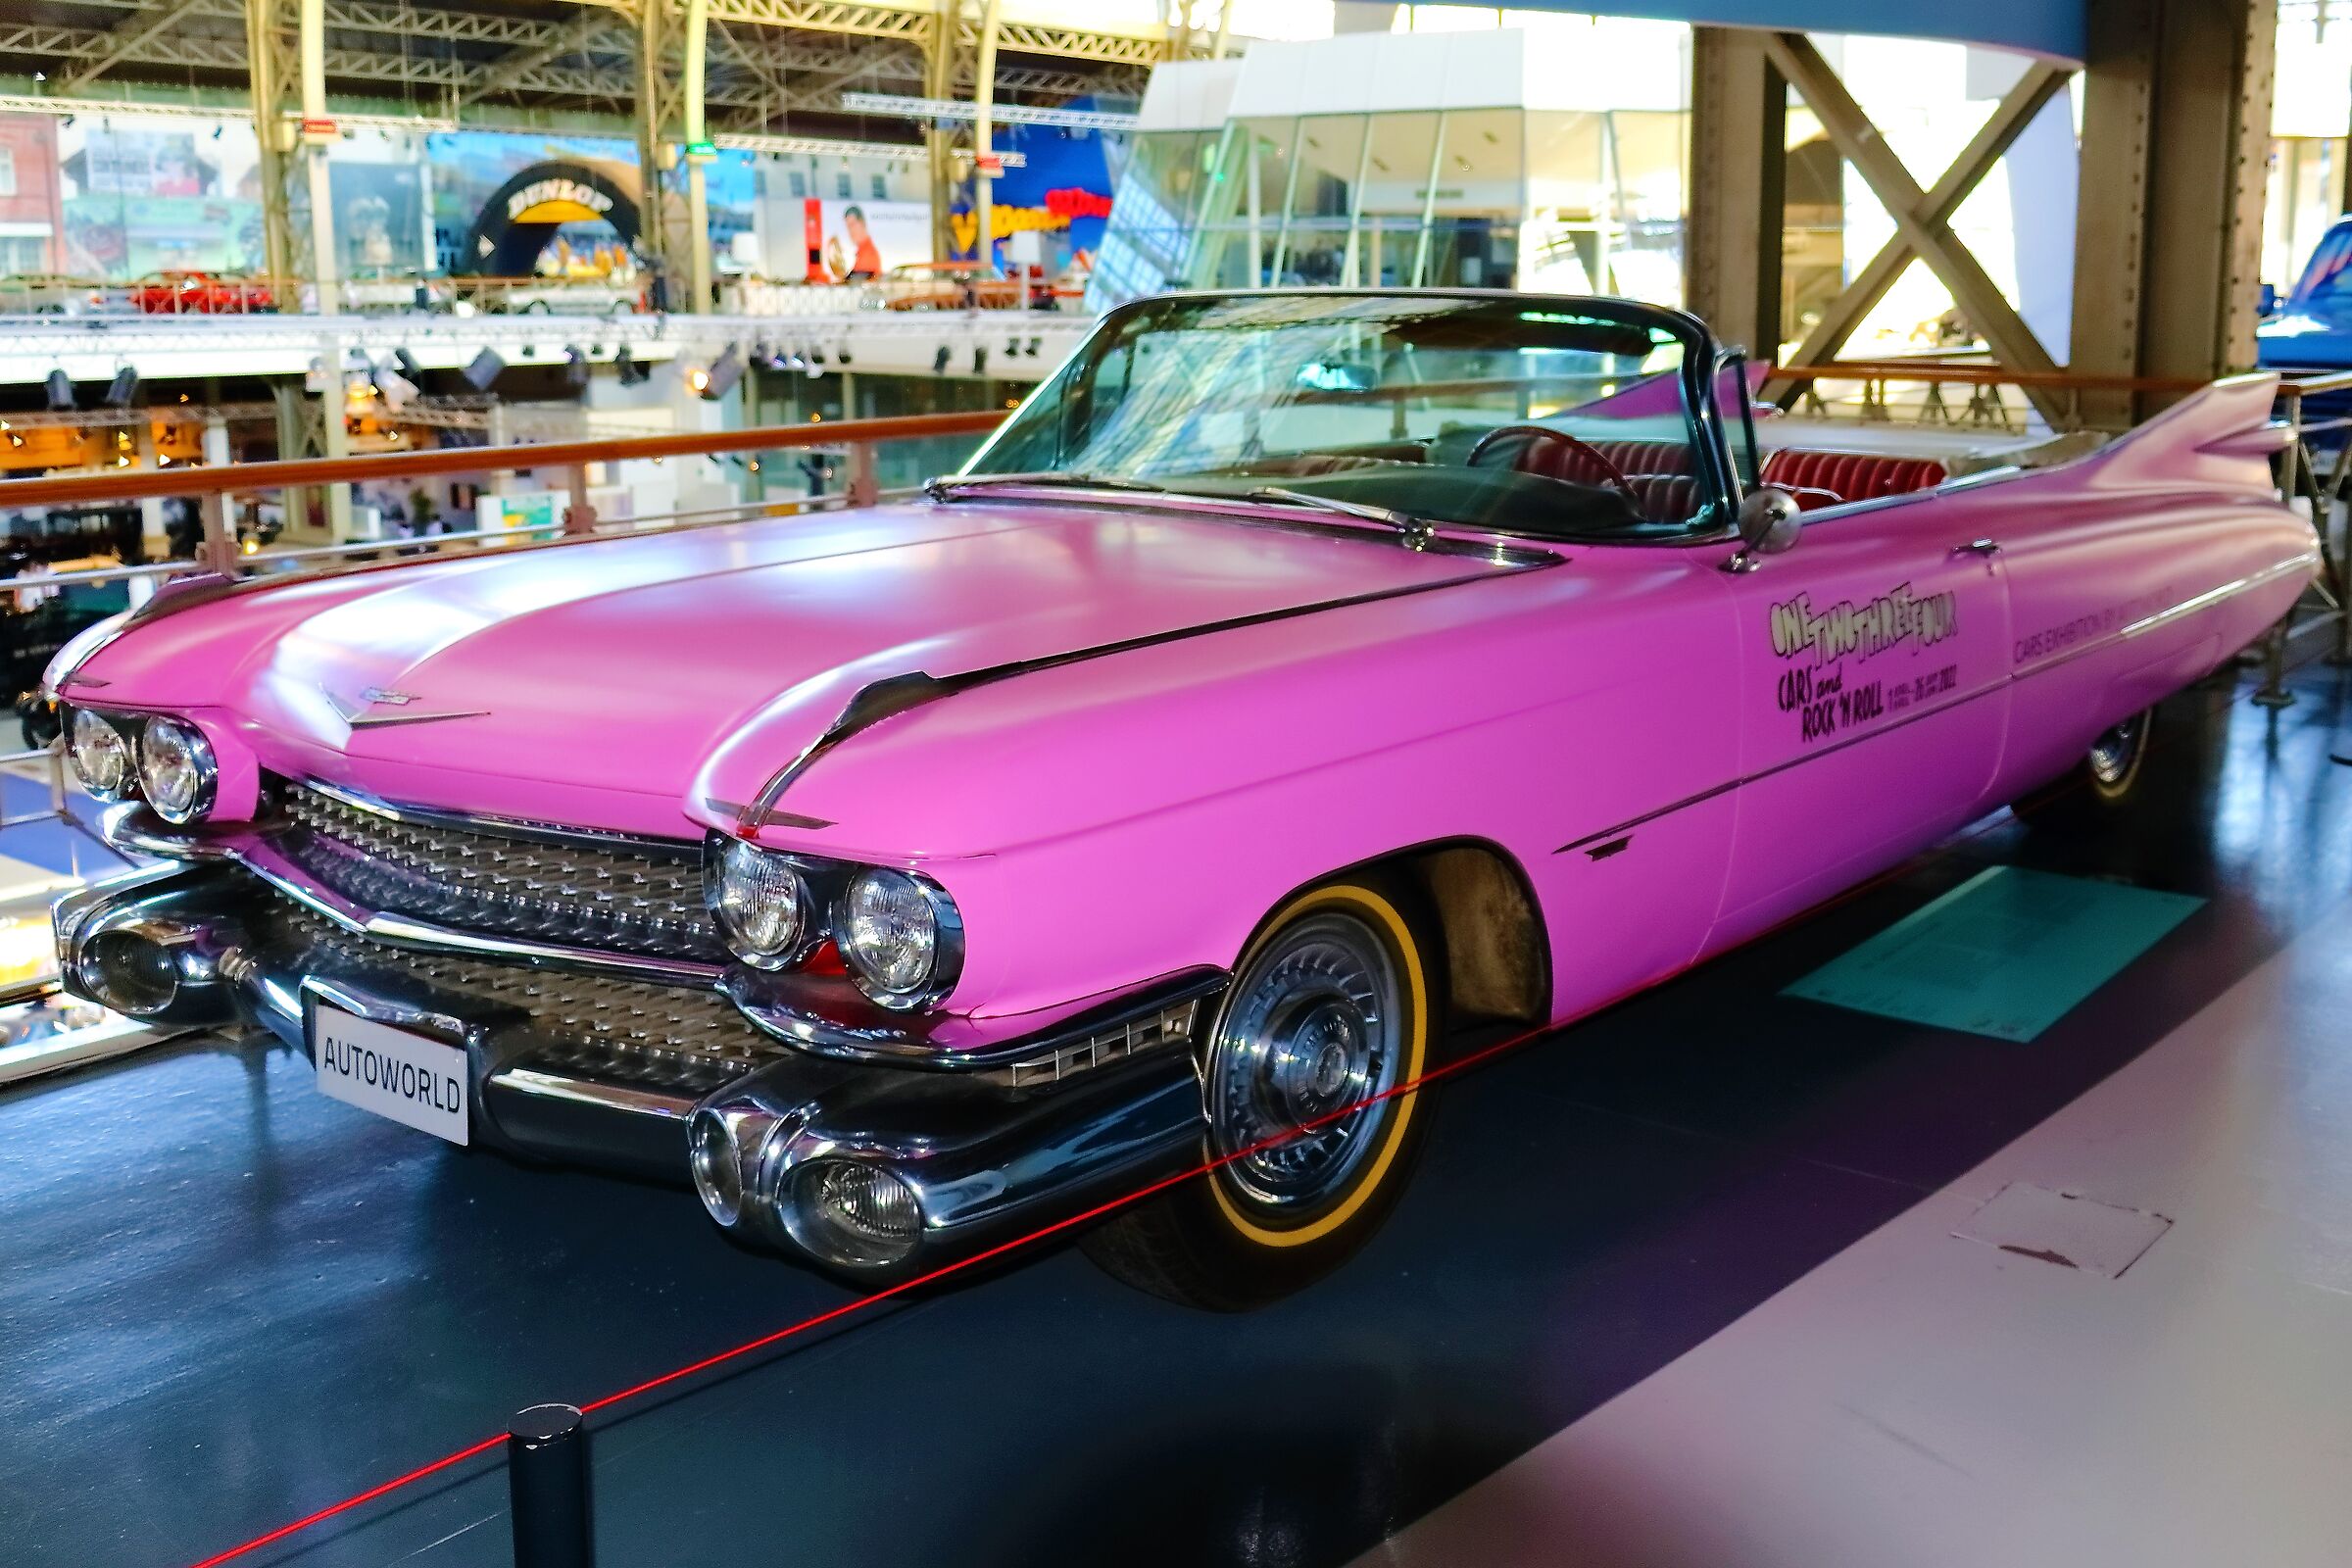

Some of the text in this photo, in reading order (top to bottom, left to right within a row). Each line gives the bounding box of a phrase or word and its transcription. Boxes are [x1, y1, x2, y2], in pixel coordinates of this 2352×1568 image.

[508, 178, 613, 220] DUNLOP
[2015, 633, 2042, 663] CARS
[1779, 662, 1842, 712] CARS and
[1802, 699, 1837, 742] ROCK
[1853, 680, 1884, 725] ROLL
[324, 1037, 461, 1113] AUTOWORLD
